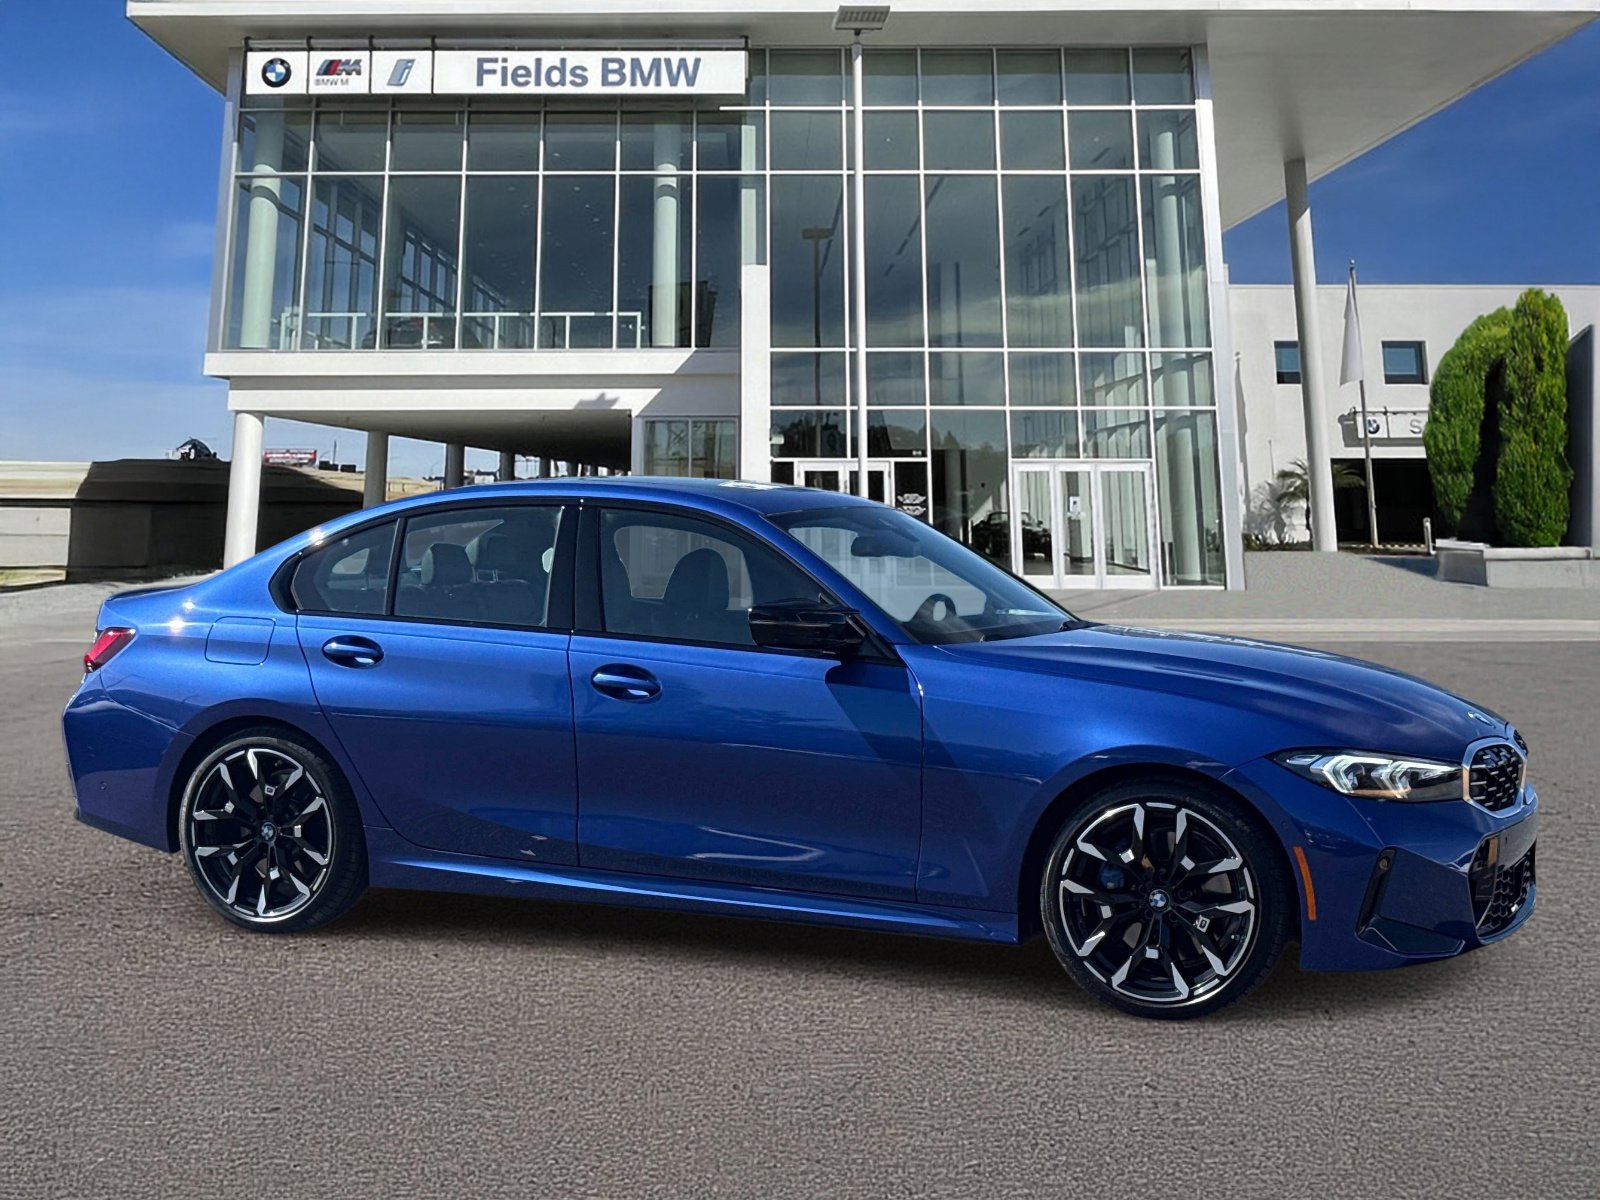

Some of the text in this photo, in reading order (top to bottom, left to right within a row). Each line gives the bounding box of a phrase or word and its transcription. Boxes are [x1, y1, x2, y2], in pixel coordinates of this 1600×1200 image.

[476, 57, 702, 88] Fields BMW
[314, 78, 349, 87] BMW M
[1409, 418, 1423, 435] S
